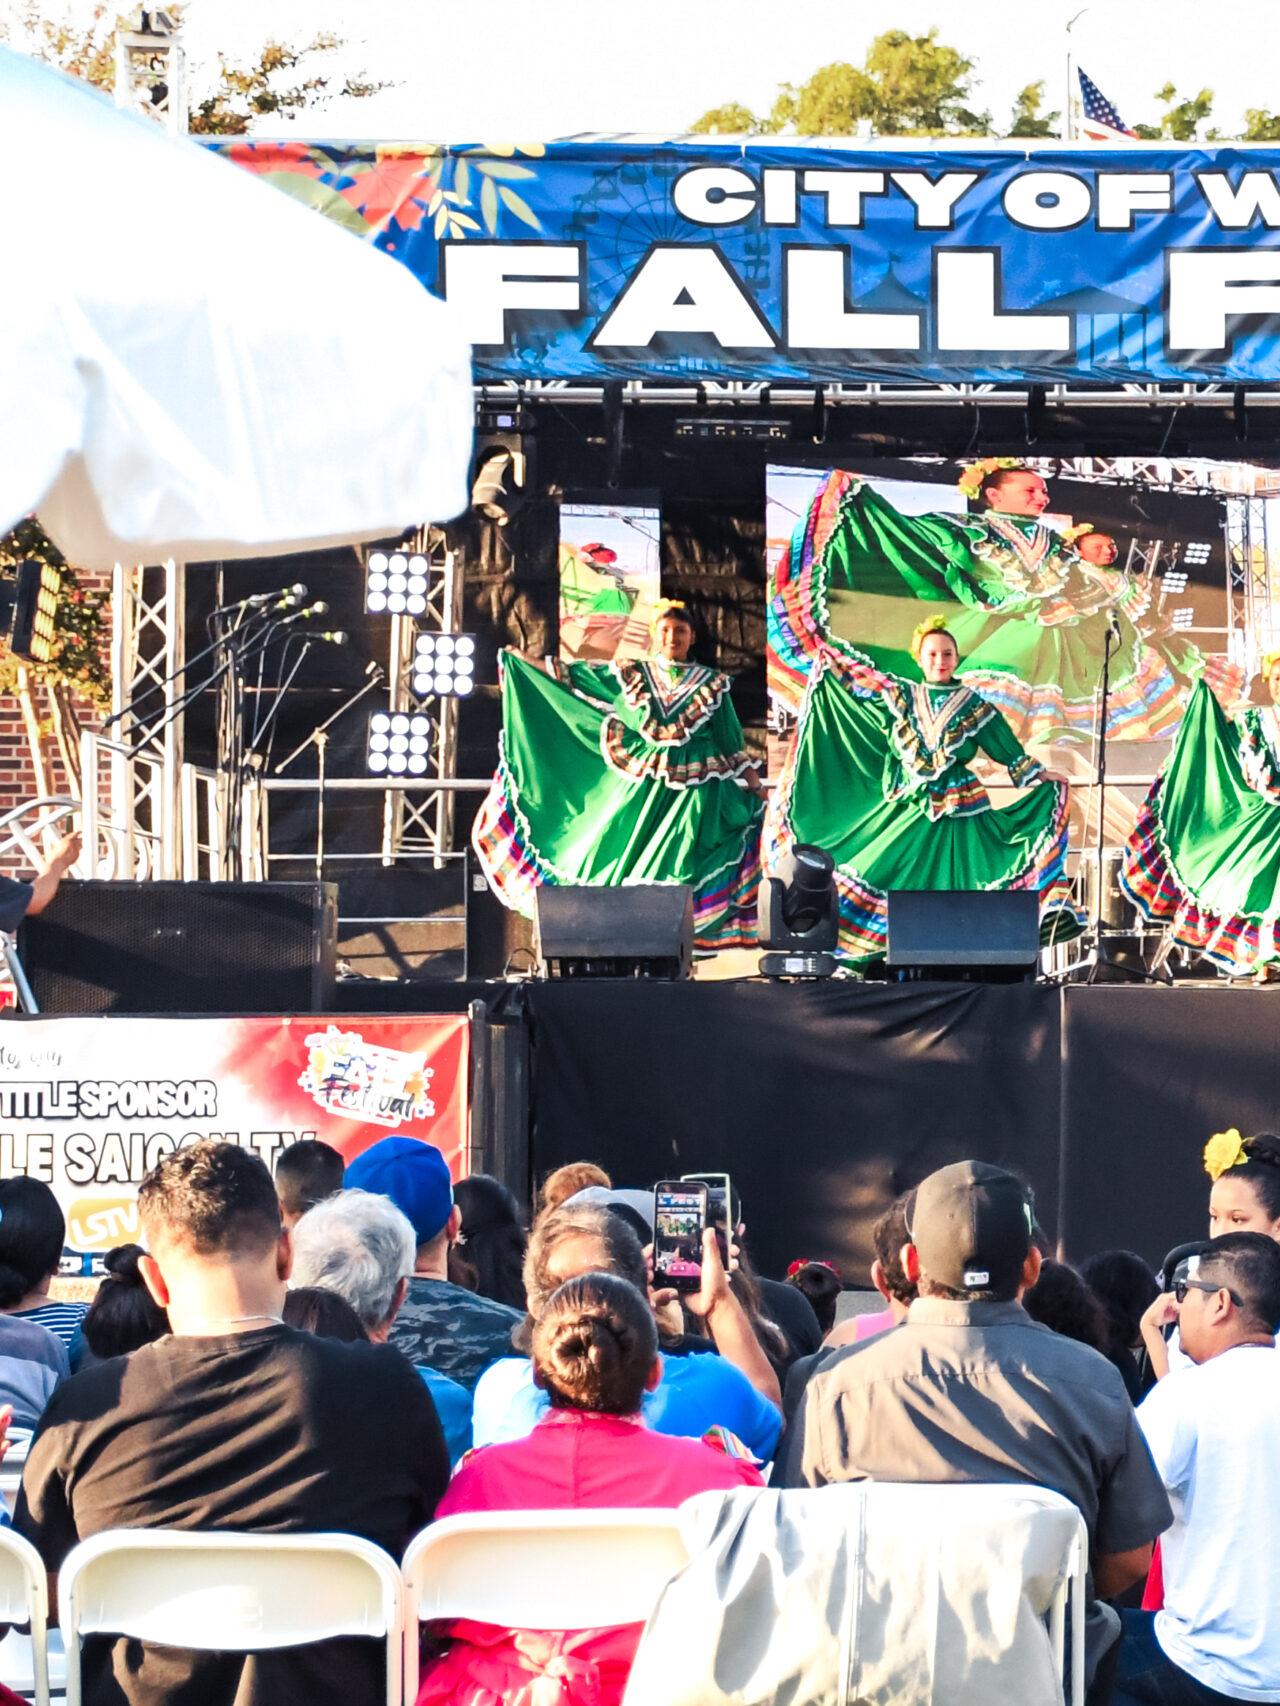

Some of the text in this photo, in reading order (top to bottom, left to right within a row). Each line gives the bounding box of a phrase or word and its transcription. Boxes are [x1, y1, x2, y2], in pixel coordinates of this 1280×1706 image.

[672, 165, 981, 227] CITY
[1003, 170, 1173, 229] OF
[444, 244, 1071, 351] FALL
[79, 1080, 217, 1119] SPONSOR
[64, 1132, 240, 1184] SAIG
[70, 1203, 139, 1246] LSTV
